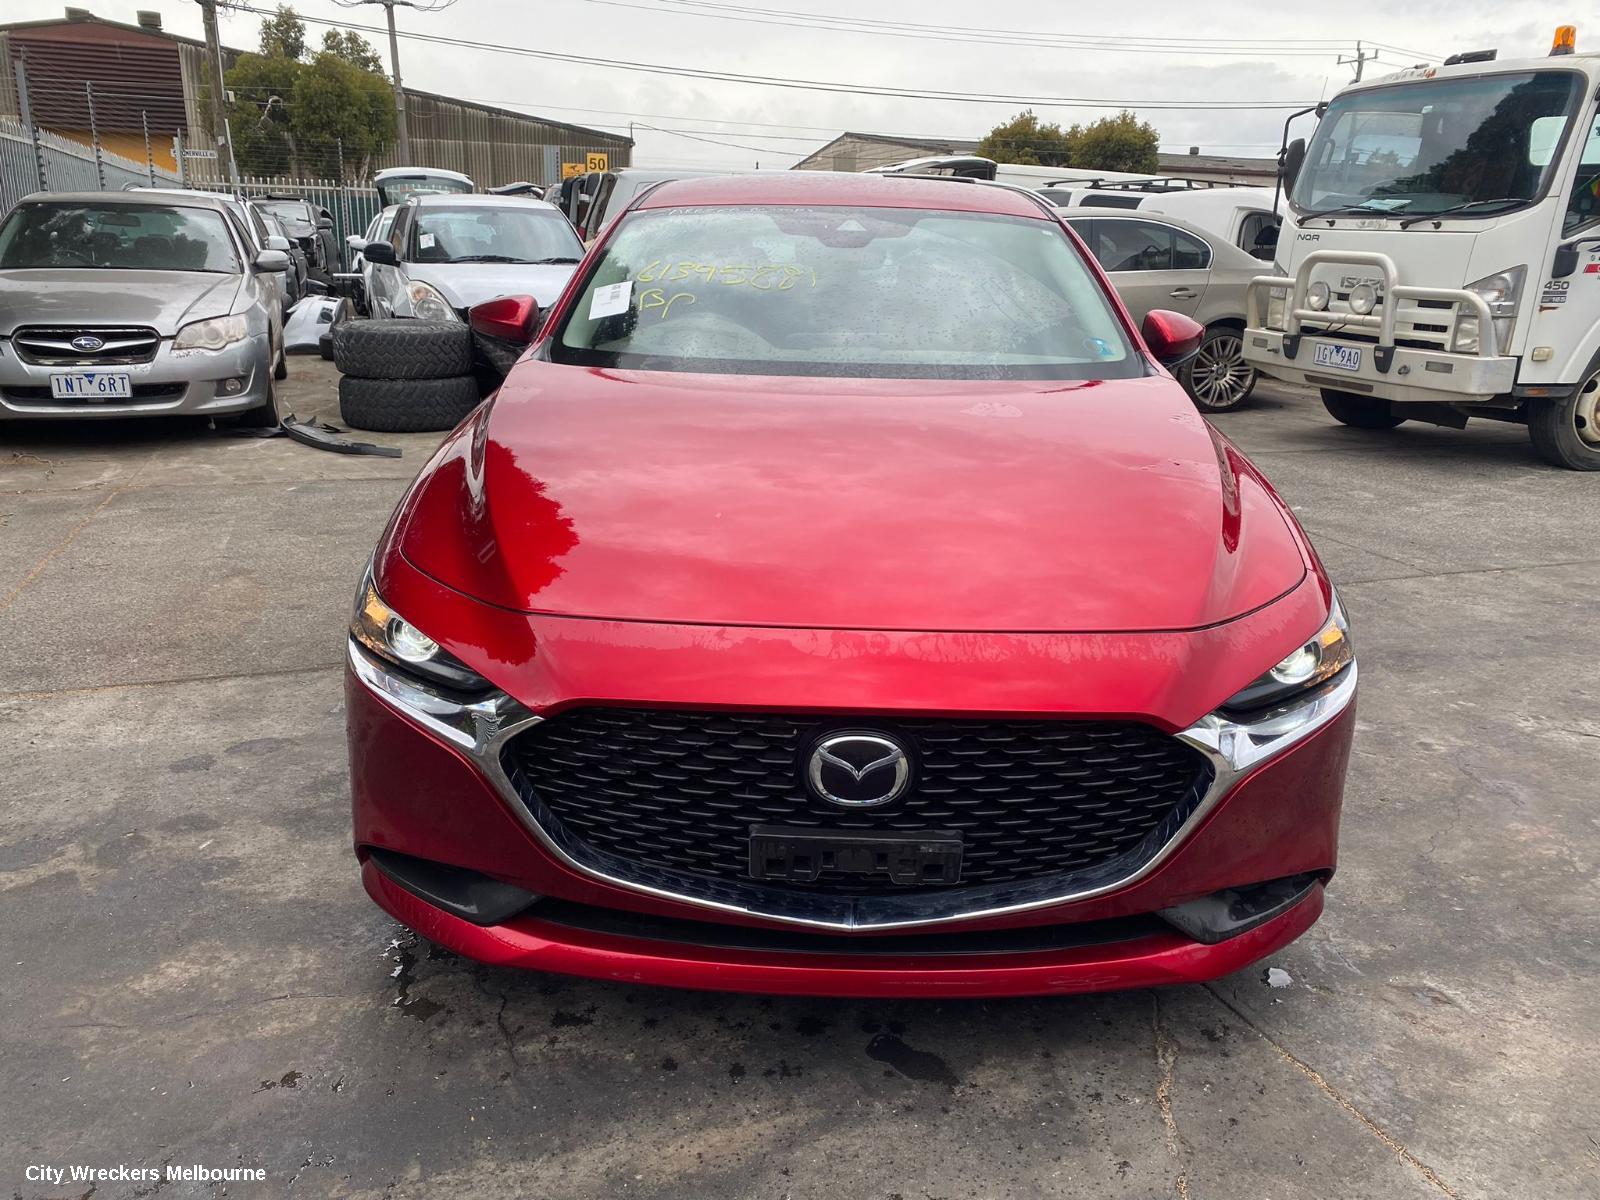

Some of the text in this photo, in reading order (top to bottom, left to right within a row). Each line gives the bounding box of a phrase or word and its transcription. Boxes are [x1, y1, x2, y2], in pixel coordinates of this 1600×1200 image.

[589, 158, 605, 170] 50
[1544, 281, 1569, 290] 450
[56, 377, 126, 393] 1NT 6RT
